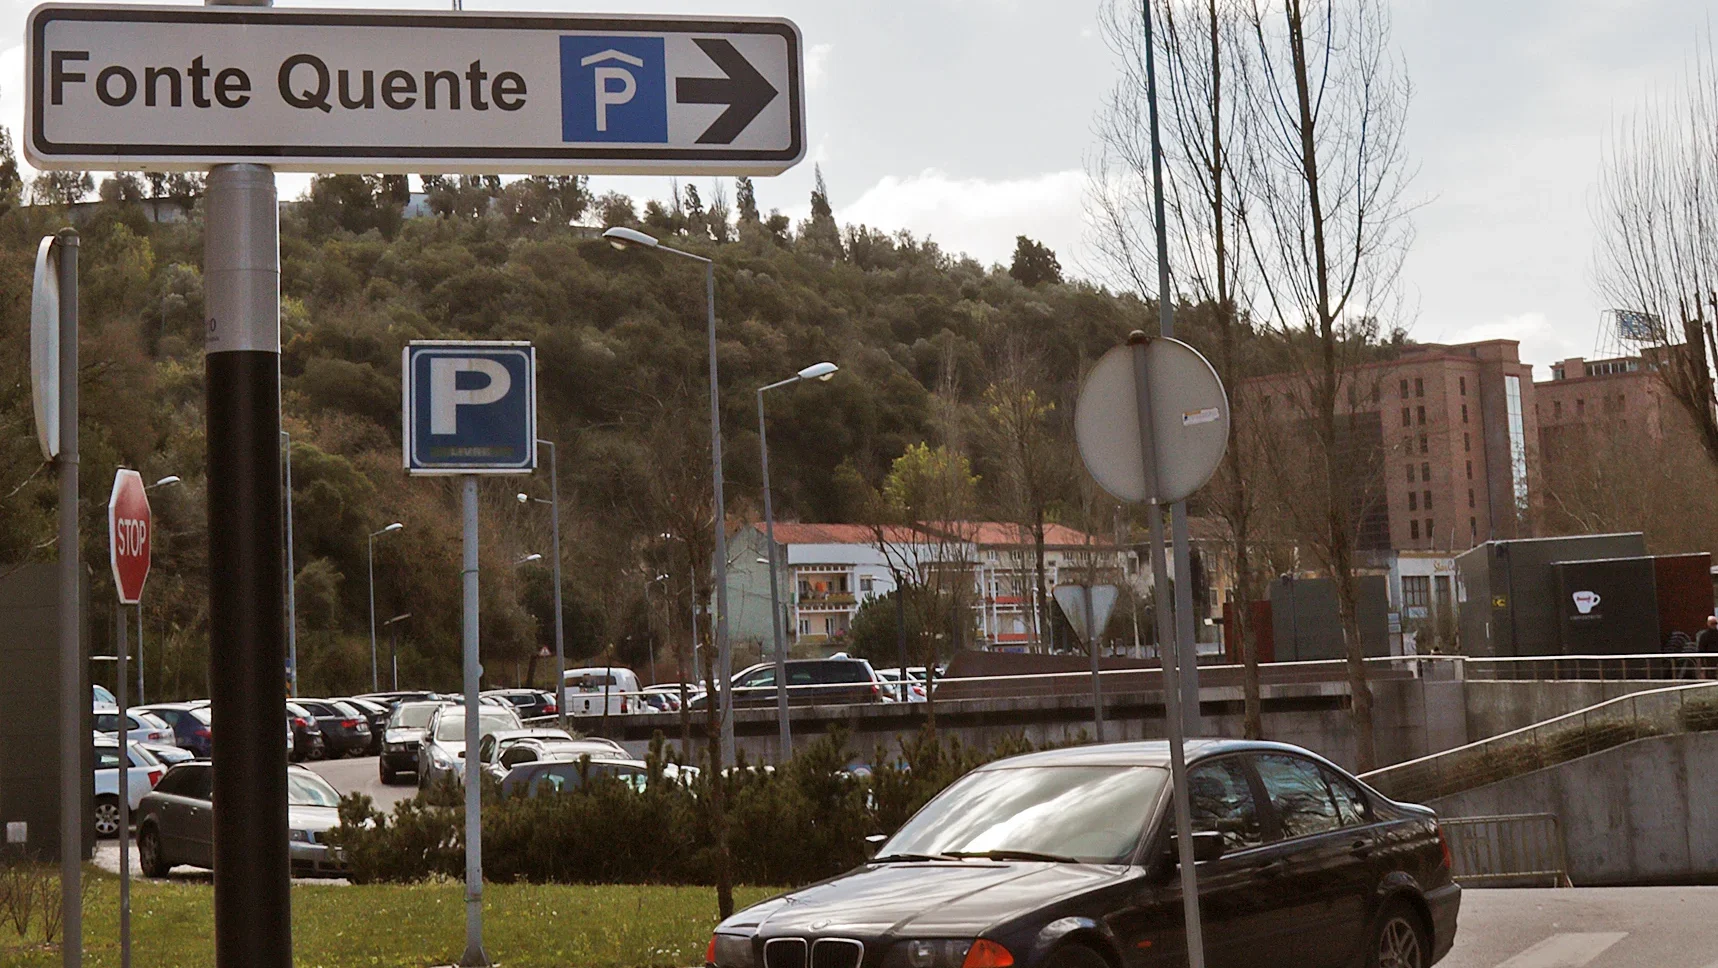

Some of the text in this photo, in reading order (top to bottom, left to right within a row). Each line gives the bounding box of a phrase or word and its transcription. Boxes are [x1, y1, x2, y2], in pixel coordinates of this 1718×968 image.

[50, 50, 527, 113] Fonte Quente
[595, 68, 637, 132] P
[430, 357, 511, 434] P
[118, 518, 146, 557] STOP
